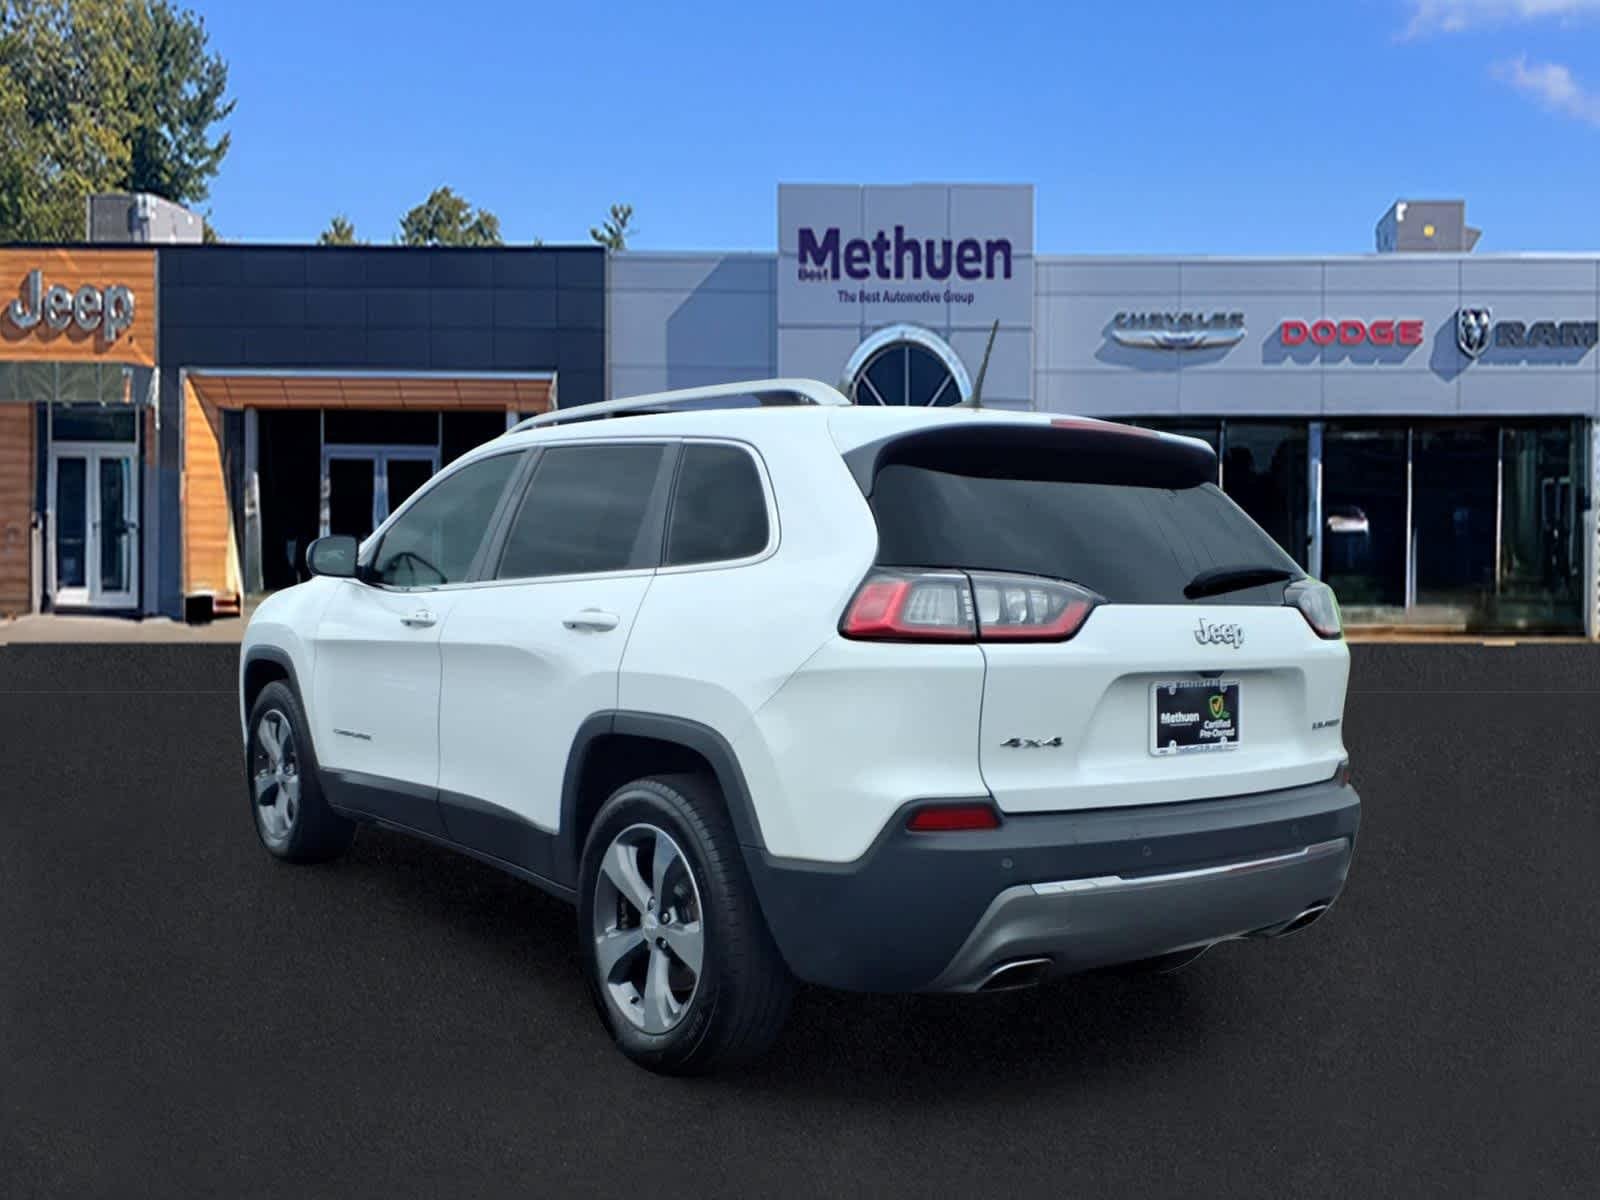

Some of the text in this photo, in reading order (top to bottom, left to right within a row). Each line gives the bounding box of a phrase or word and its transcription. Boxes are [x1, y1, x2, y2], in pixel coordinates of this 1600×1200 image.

[798, 226, 1012, 280] Methuen
[798, 268, 829, 281] Best
[9, 270, 136, 342] Jeep
[838, 290, 975, 306] The Best Automotive Group
[1280, 320, 1424, 345] DODGE
[1495, 321, 1598, 347] RAM
[1194, 618, 1244, 649] Jeep
[1161, 712, 1200, 723] Methuen
